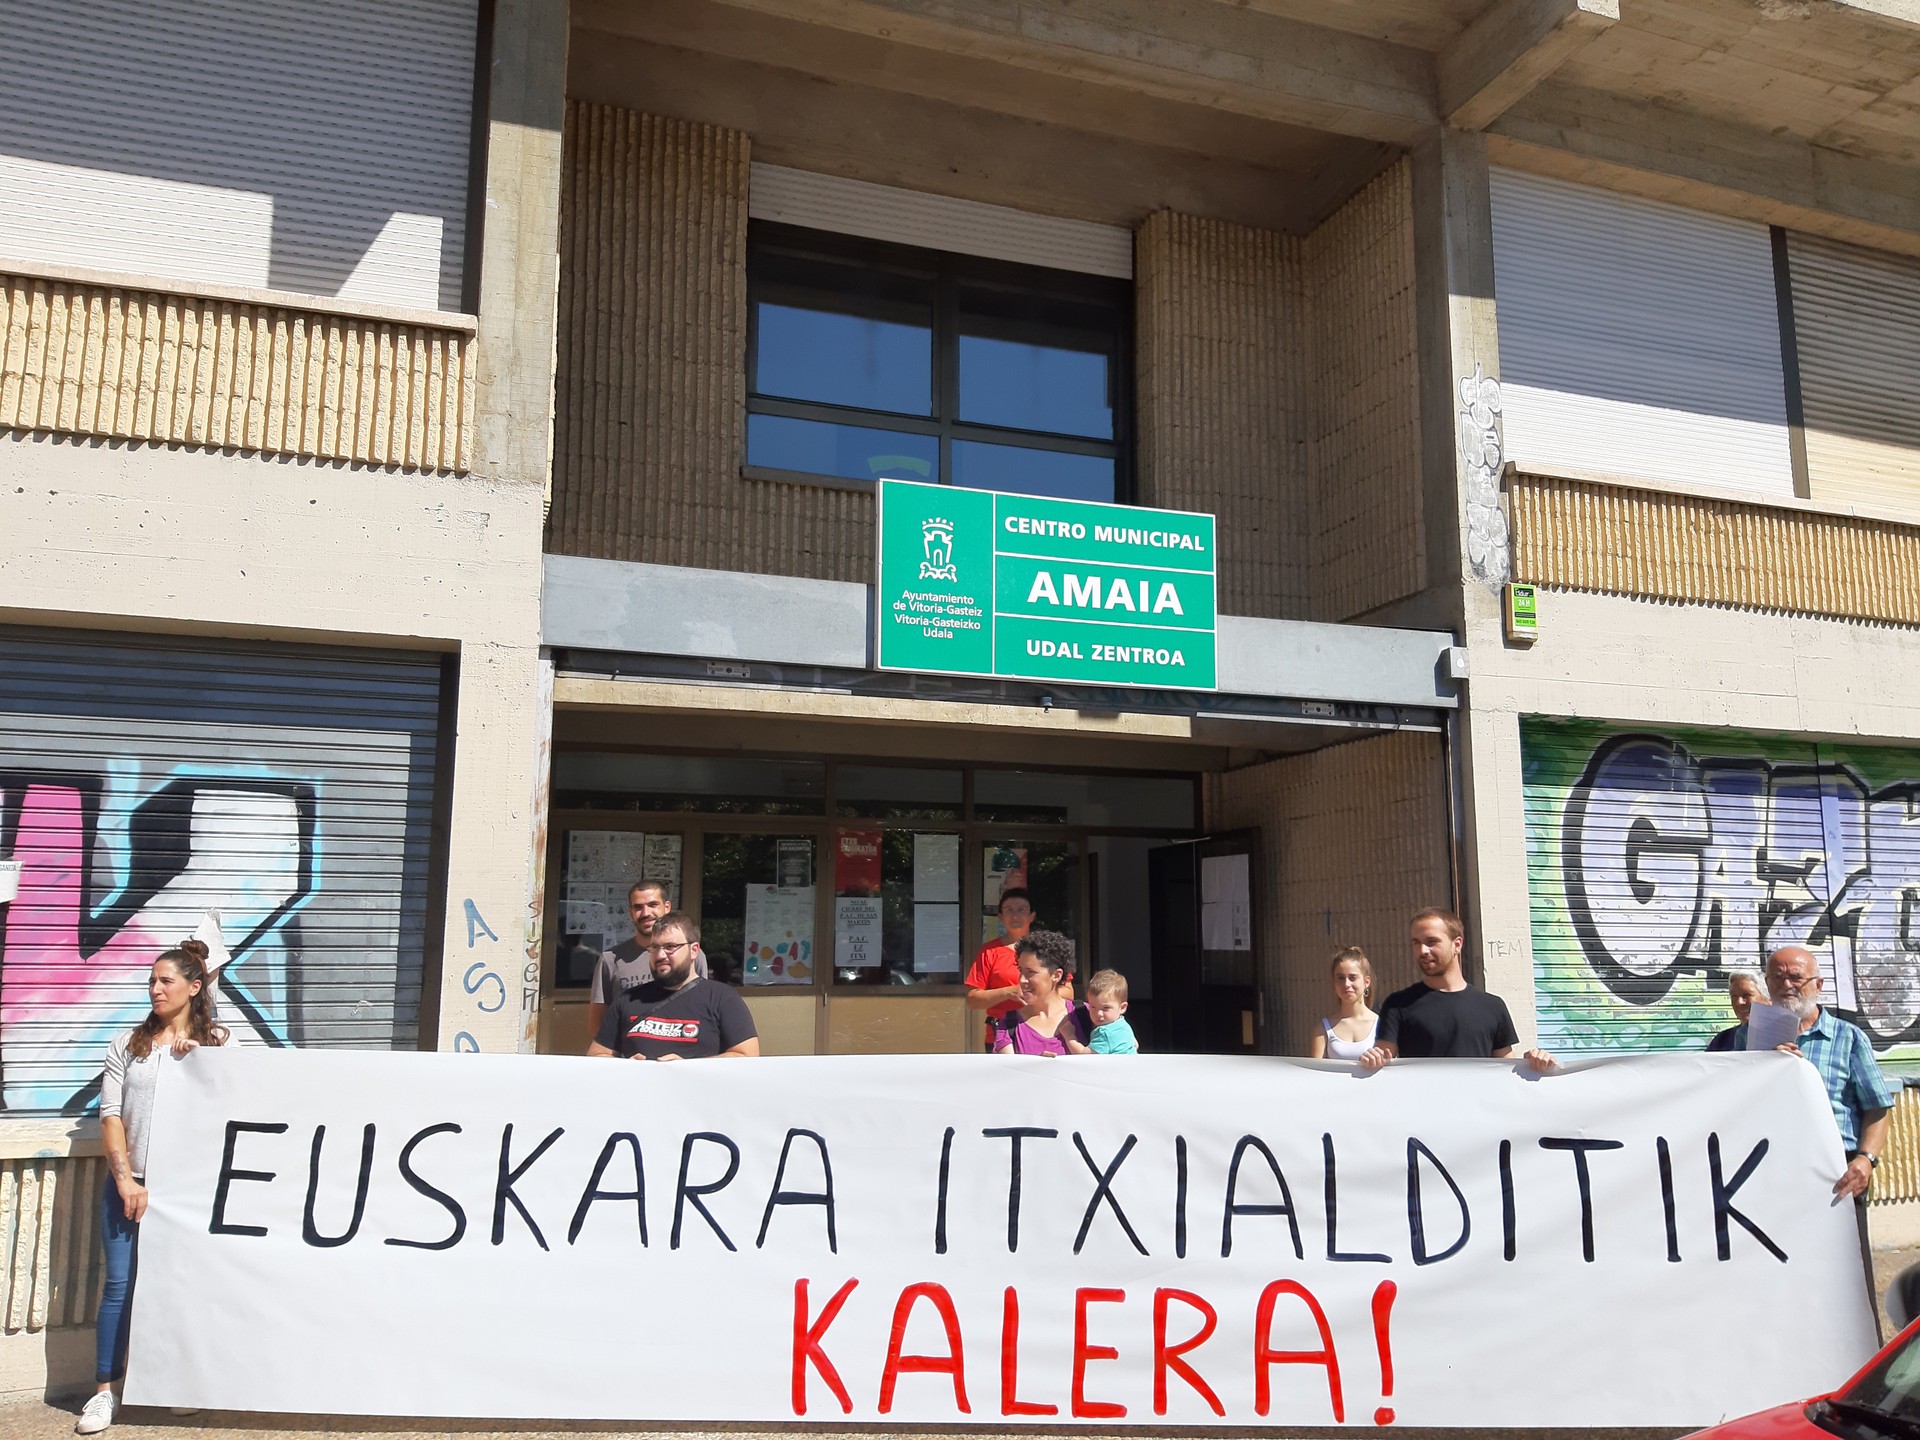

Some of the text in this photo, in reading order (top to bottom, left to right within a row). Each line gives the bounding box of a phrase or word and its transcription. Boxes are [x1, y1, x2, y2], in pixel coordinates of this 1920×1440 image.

[1004, 516, 1204, 552] CENTRO MUNICIPAL
[902, 590, 974, 605] Ayuntamiento
[1027, 571, 1184, 616] AMAIA
[893, 600, 983, 617] de Vitoria-Gasteiz
[894, 613, 981, 630] Vitoria-Gasteizko
[923, 627, 953, 639] Udala
[1026, 639, 1185, 667] UDAL ZENTROA
[208, 1119, 1789, 1266] EUSKARA ITXIALDITIK
[791, 1276, 1398, 1427] KALERA!
